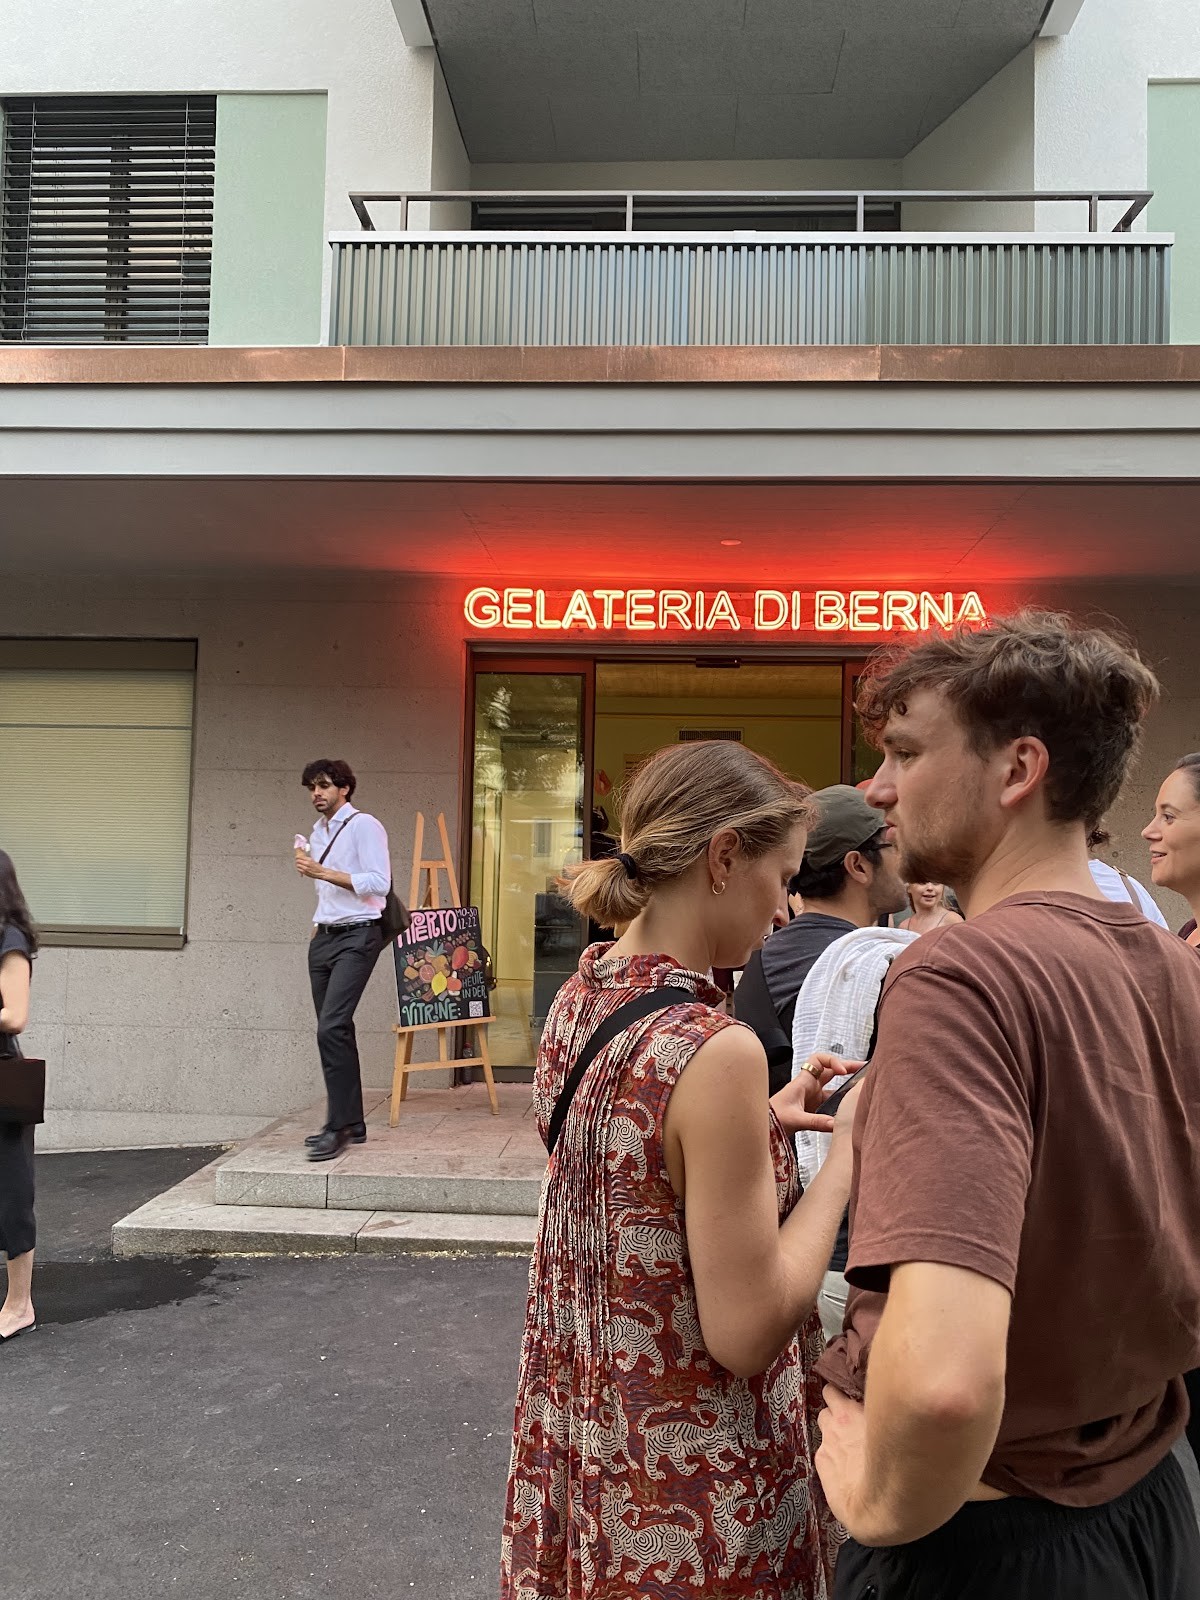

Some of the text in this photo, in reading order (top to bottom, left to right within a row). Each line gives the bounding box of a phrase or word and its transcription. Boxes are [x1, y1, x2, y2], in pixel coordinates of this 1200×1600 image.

[463, 586, 988, 631] GELATERIA DI BERNA
[455, 907, 477, 917] MO-SO
[462, 970, 484, 988] HEUTE
[462, 985, 487, 999] IN DER
